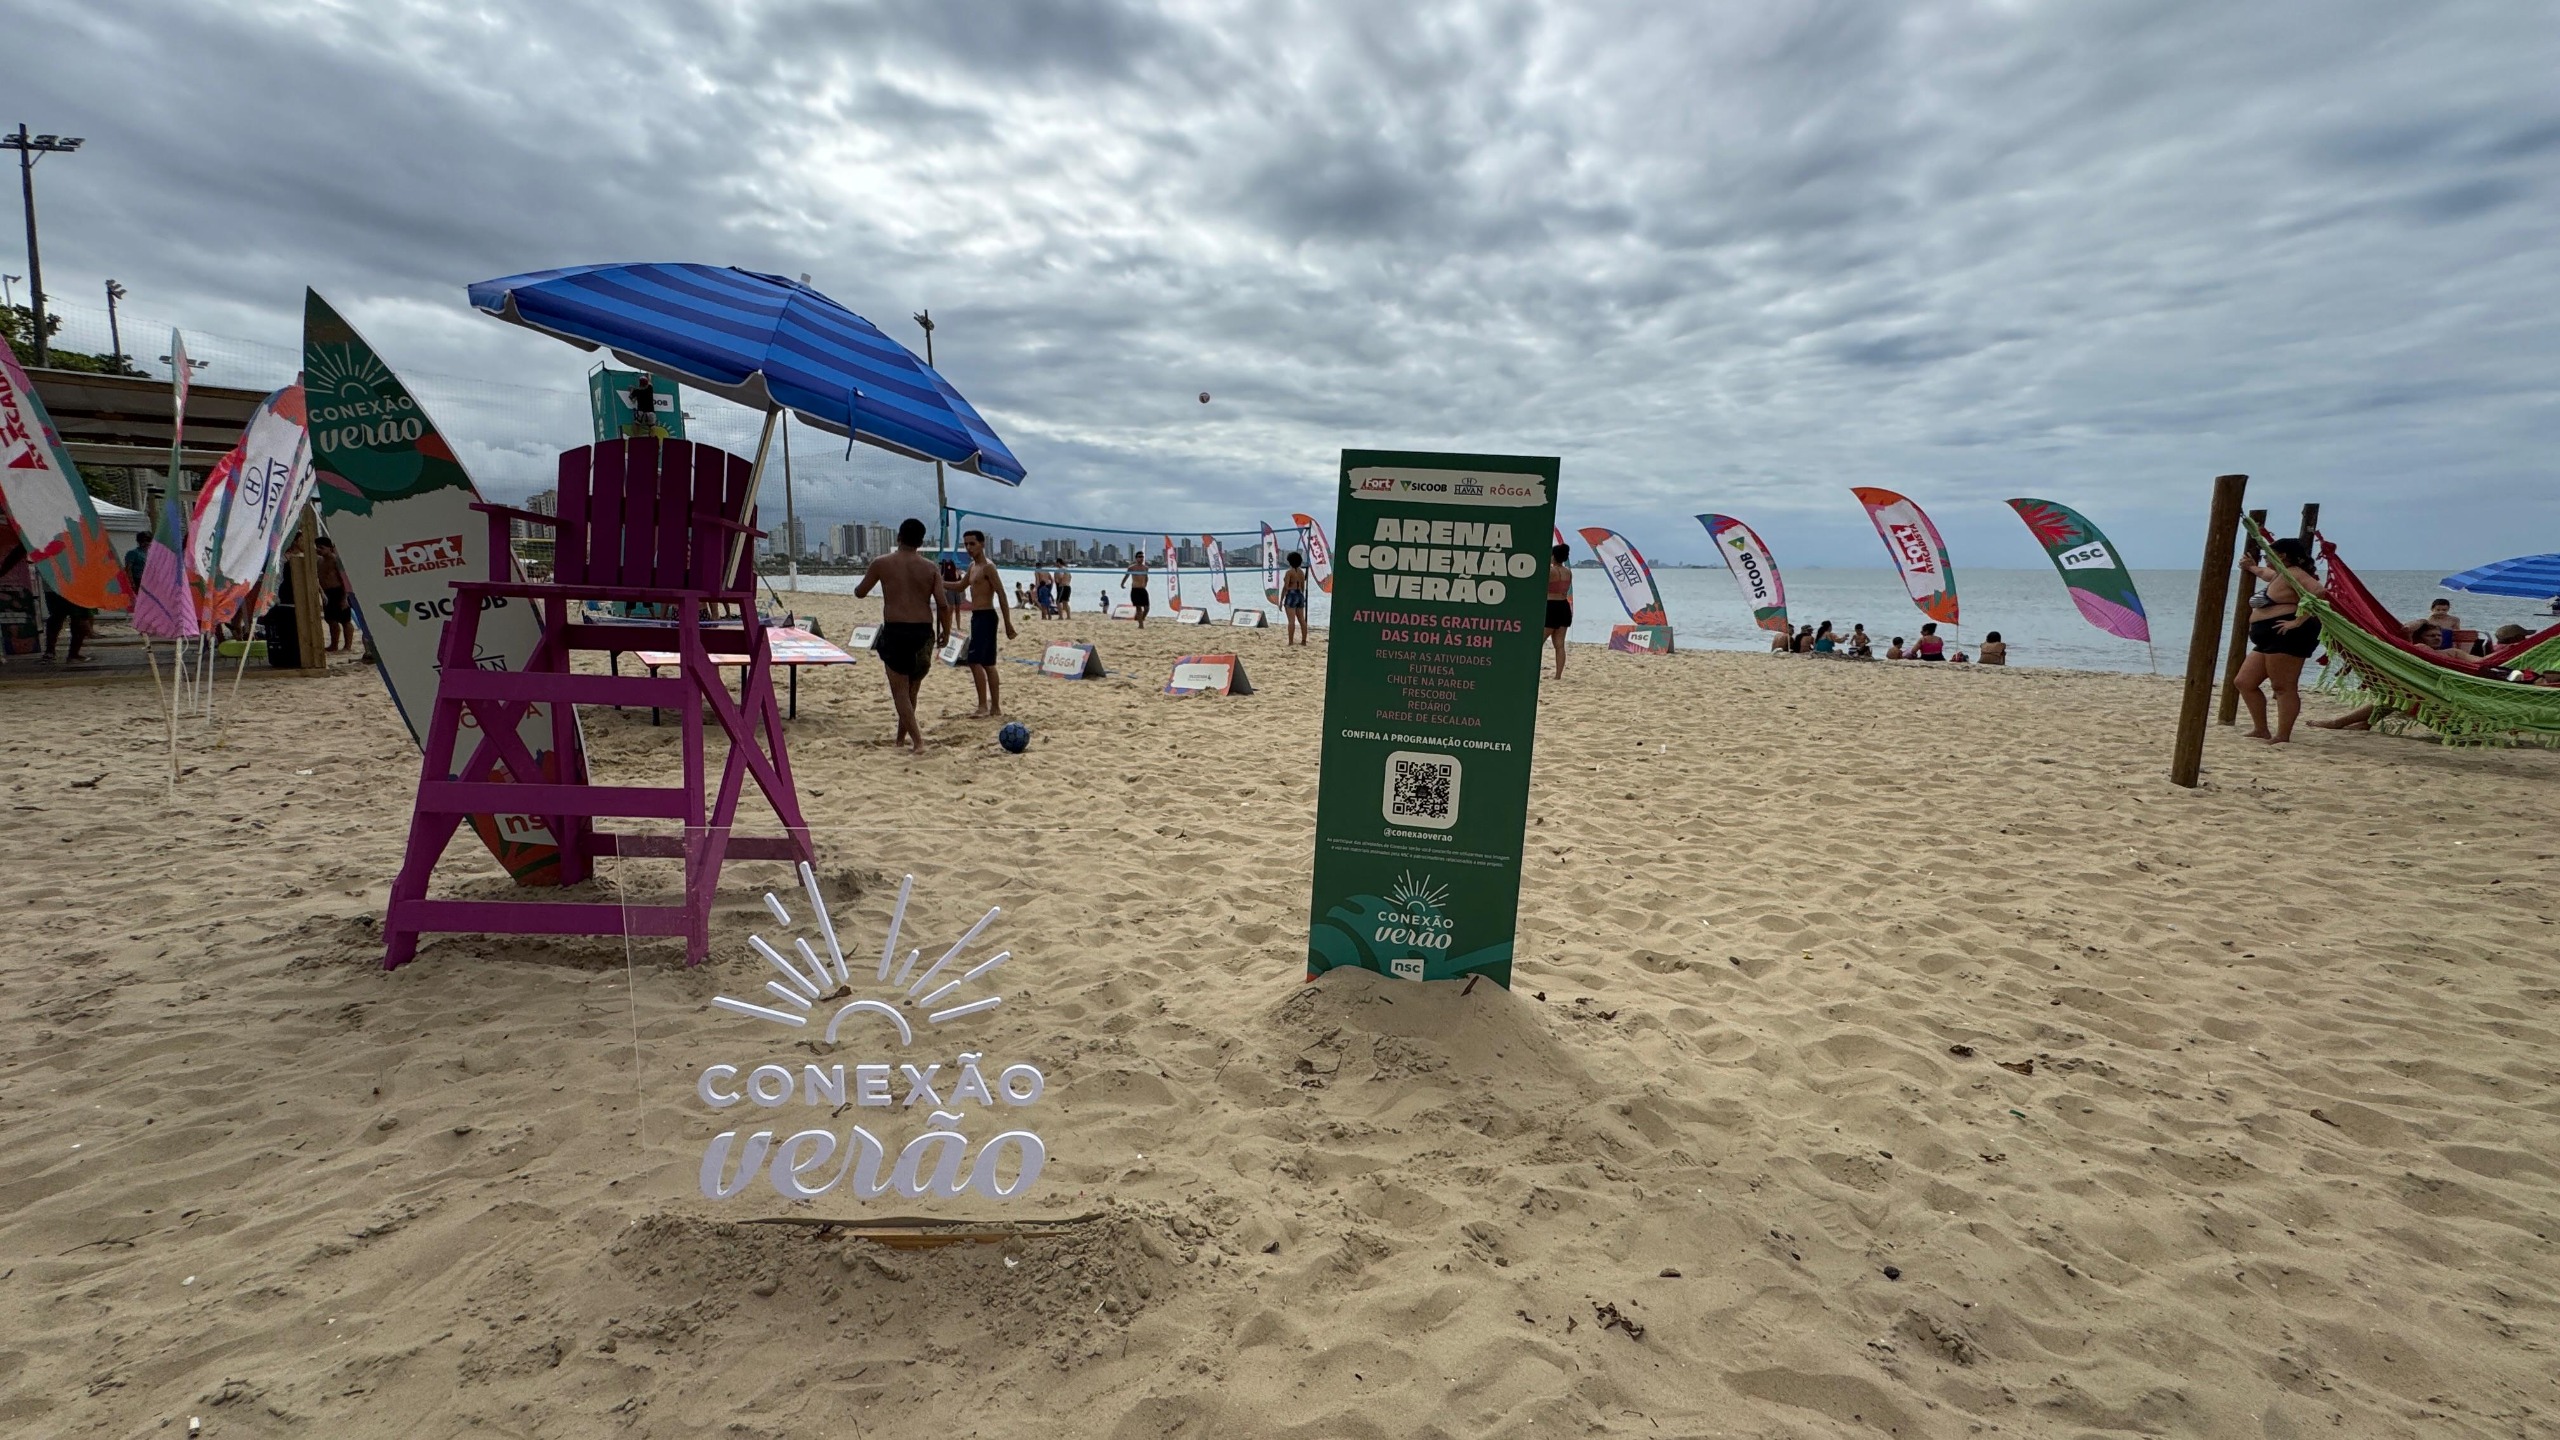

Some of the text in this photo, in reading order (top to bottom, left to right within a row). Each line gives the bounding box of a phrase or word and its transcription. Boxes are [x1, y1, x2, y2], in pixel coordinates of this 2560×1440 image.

[309, 395, 413, 423] CONEXÃO
[319, 414, 423, 453] verão
[1366, 478, 1447, 492] Fort SICOOB
[1454, 484, 1532, 497] HAVAN RÔGGA
[1374, 517, 1513, 548] ARENA
[387, 537, 459, 567] Fort
[1893, 525, 1928, 571] Fort
[1908, 523, 1935, 574] ATACADISTA
[2064, 546, 2104, 566] nsc
[384, 557, 466, 577] ATACADISTA
[1348, 545, 1537, 579] CONEXÃO
[1616, 553, 1642, 587] HAVAN
[1740, 552, 1767, 600] SICOOB
[1373, 573, 1506, 605] VERÃO
[414, 595, 508, 621] SICOB
[1353, 610, 1522, 633] ATIVIDADES GRATUITAS
[1381, 629, 1493, 648] DAS 10H ÀS 18H
[1630, 632, 1649, 641] nsc
[1375, 649, 1492, 666] REVISAR AS ATIVIDADES
[1409, 664, 1455, 676] FUTMESA
[1387, 674, 1476, 690] CHUTE NA PAREDE
[1402, 688, 1458, 701] FRESCOBOL
[1376, 710, 1482, 727] PAREDE DE ESCALADA
[1341, 729, 1512, 752] CONFIRA A PROGRAMAÇÃO COMPLETA
[1383, 827, 1453, 842] @conexaoverao
[1377, 911, 1454, 929] CONEXÃO
[1375, 926, 1452, 950] verão
[1394, 960, 1421, 974] nsc
[697, 1051, 1044, 1107] CONEXÃO
[699, 1110, 1046, 1200] verão
